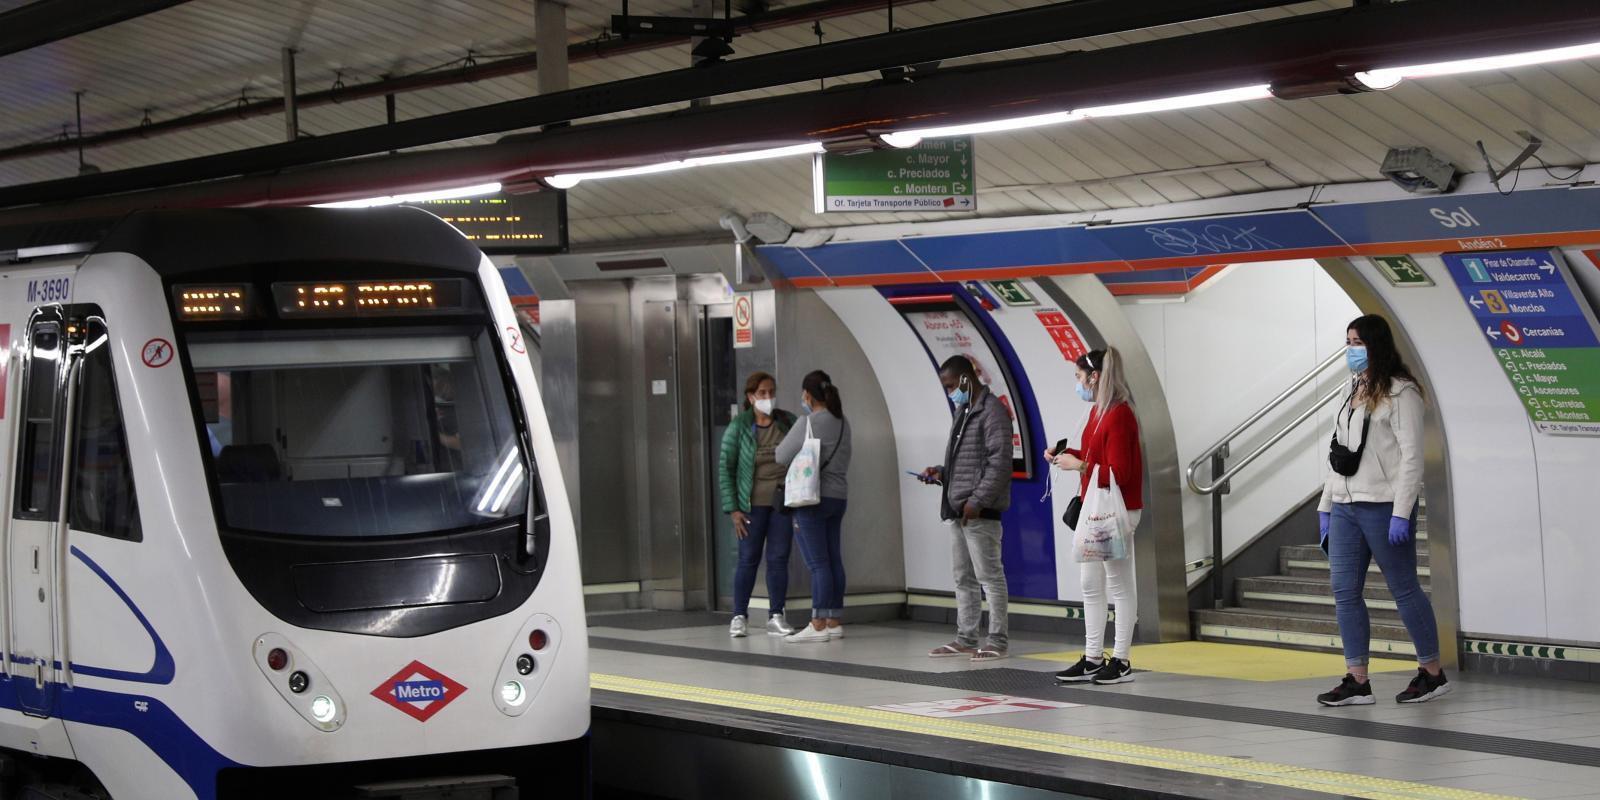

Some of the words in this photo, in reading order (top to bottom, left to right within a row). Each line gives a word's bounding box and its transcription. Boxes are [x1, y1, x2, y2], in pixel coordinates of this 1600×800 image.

[906, 156, 915, 164] c.
[918, 154, 950, 165] Mayor
[888, 170, 896, 178] c.
[899, 168, 950, 178] Preciados
[893, 185, 902, 193] c.
[905, 183, 947, 193] Montera
[848, 200, 872, 209] Tarjeta
[874, 200, 912, 208] Transporte
[913, 198, 941, 207] Público
[1429, 206, 1480, 228] Sol
[1458, 238, 1496, 250] Andén
[1495, 238, 1508, 248] 2
[1483, 258, 1500, 268] Pinar
[1499, 258, 1508, 267] de
[1469, 261, 1484, 280] 1
[1491, 272, 1541, 282] Valdecarros
[27, 278, 69, 303] M-3690
[1501, 289, 1538, 299] Villaverde
[1538, 289, 1554, 298] Alto
[1487, 293, 1503, 311] 3
[1509, 304, 1545, 313] Moncloa
[1522, 327, 1565, 337] Cercanías
[1520, 349, 1545, 358] Alcalá
[1526, 361, 1567, 371] Preciados
[1533, 373, 1558, 384] Mayor
[1533, 386, 1579, 395] Ascensores
[1550, 400, 1585, 408] Carretas
[1555, 410, 1590, 420] Montera
[397, 685, 440, 698] Metro
